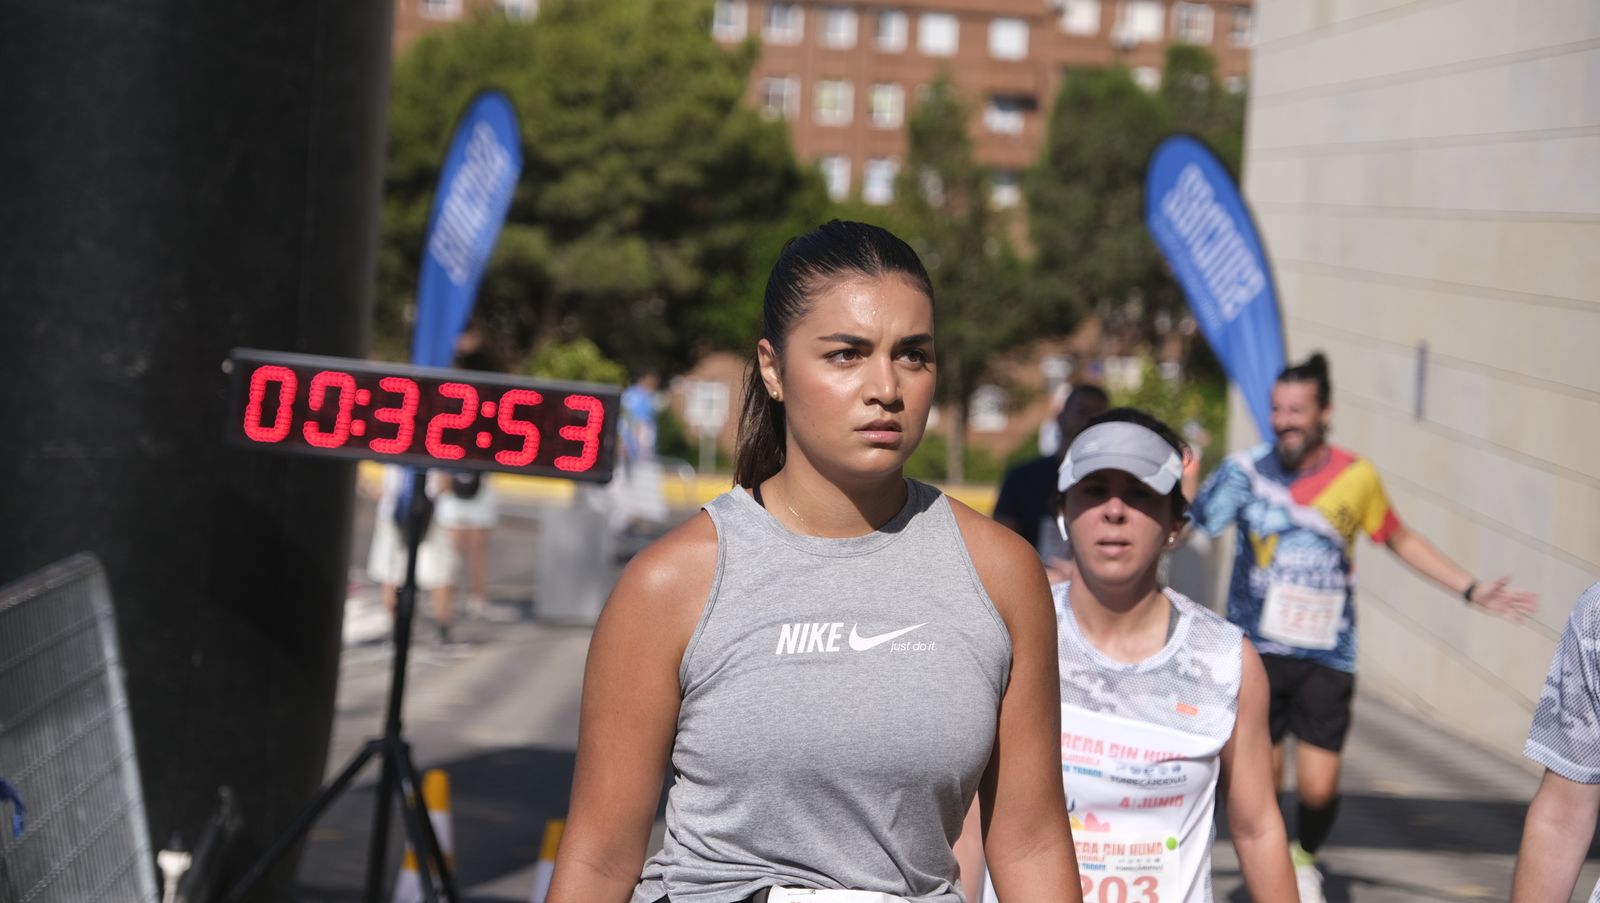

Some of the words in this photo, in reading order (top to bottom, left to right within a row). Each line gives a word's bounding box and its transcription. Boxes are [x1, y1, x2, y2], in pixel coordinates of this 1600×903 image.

[244, 365, 604, 472] 00:32:53
[775, 622, 844, 655] NIKE
[890, 641, 910, 653] just
[912, 641, 926, 651] do
[927, 641, 936, 651] it
[1108, 743, 1138, 760] SIN
[1143, 749, 1187, 764] HUM
[1137, 795, 1185, 809] JUNIO
[1103, 843, 1125, 856] SIN
[1129, 842, 1163, 856] HUMO
